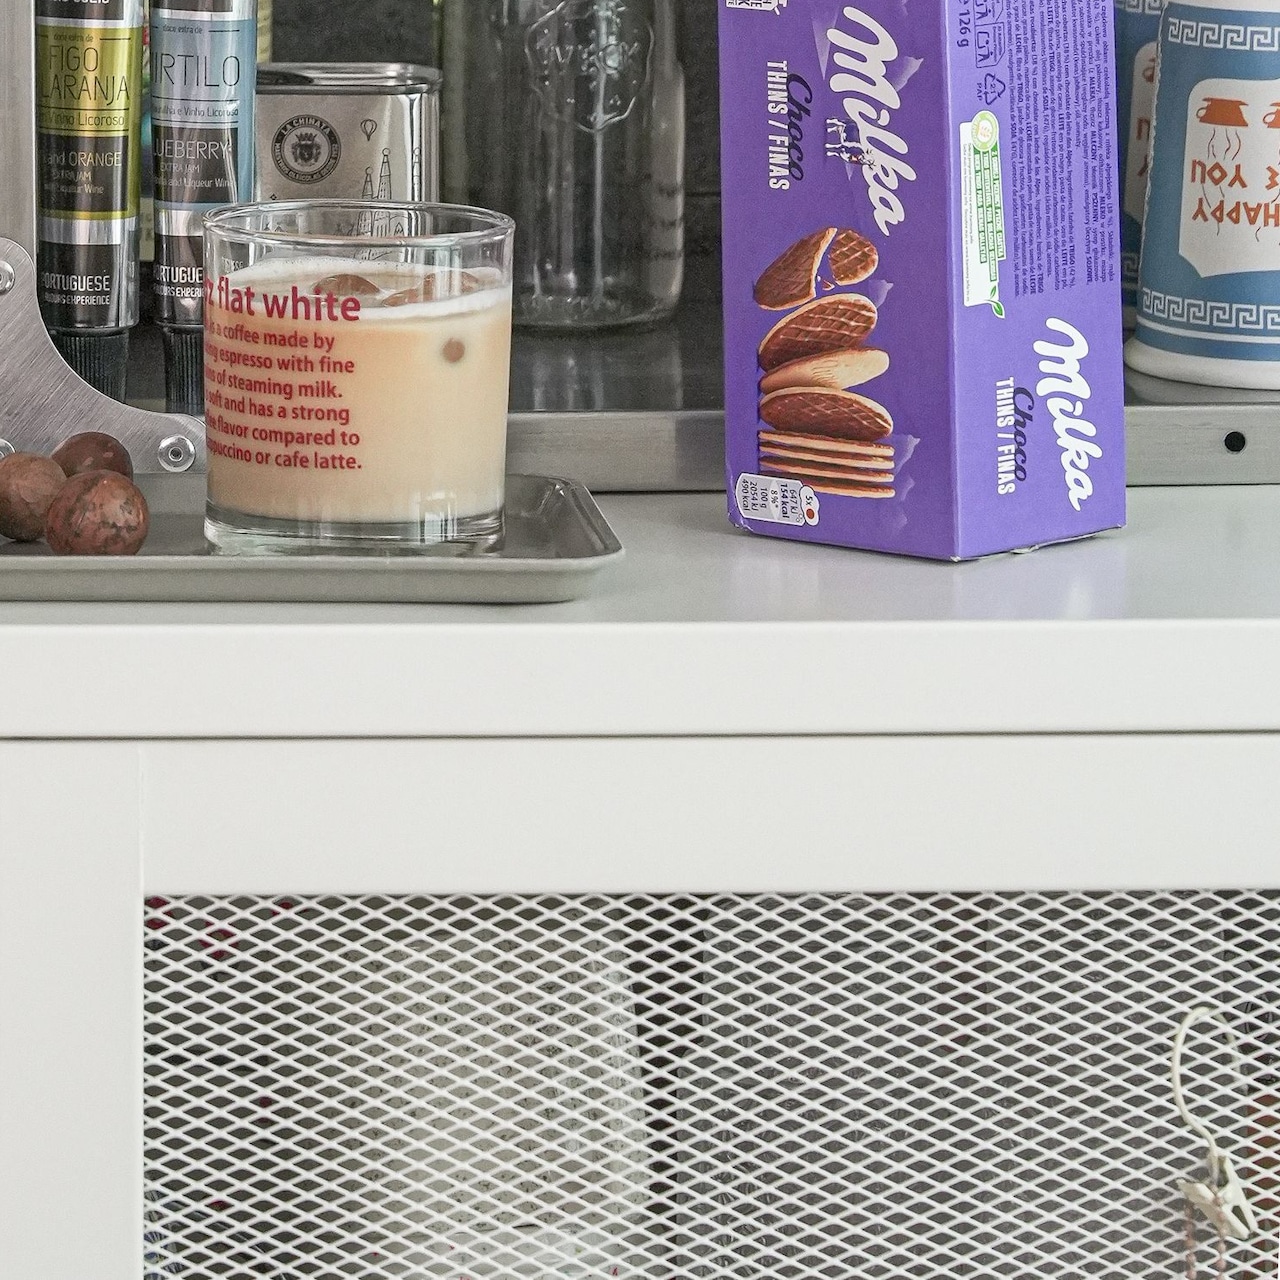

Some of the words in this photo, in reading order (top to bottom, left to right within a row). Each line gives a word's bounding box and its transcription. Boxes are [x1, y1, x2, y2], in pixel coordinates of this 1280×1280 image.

[958, 10, 970, 34] 126
[957, 38, 969, 48] g
[49, 45, 98, 72] FIGO
[41, 74, 130, 106] LARANJA
[768, 60, 788, 114] THINS
[78, 112, 125, 126] Licoroso
[785, 72, 812, 182] Choco
[826, 6, 919, 235] Milka
[69, 151, 122, 167] ORANGE
[768, 135, 790, 190] FINAS
[1191, 160, 1248, 188] YOU
[1192, 198, 1280, 228] HAPPY
[218, 276, 256, 316] flat
[263, 286, 362, 322] white
[223, 324, 260, 345] coffee
[264, 330, 308, 349] made
[314, 332, 335, 353] by
[220, 346, 273, 371] espresso
[277, 354, 314, 373] with
[320, 357, 355, 374] fine
[228, 374, 293, 400] steaming
[298, 381, 343, 399] milk.
[224, 396, 246, 414] and
[249, 398, 274, 417] has
[278, 407, 287, 420] a
[292, 405, 350, 426] strong
[996, 377, 1014, 428] THINS
[1032, 317, 1103, 512] Milka
[218, 416, 250, 440] flavor
[252, 426, 336, 448] compared
[340, 432, 360, 446] to
[1013, 386, 1034, 482] Choco
[256, 450, 272, 466] or
[274, 451, 310, 468] cafe
[314, 452, 362, 471] latte.
[998, 444, 1016, 495] FINAS
[780, 483, 788, 499] 154
[790, 489, 798, 504] 647
[781, 500, 790, 518] kcal
